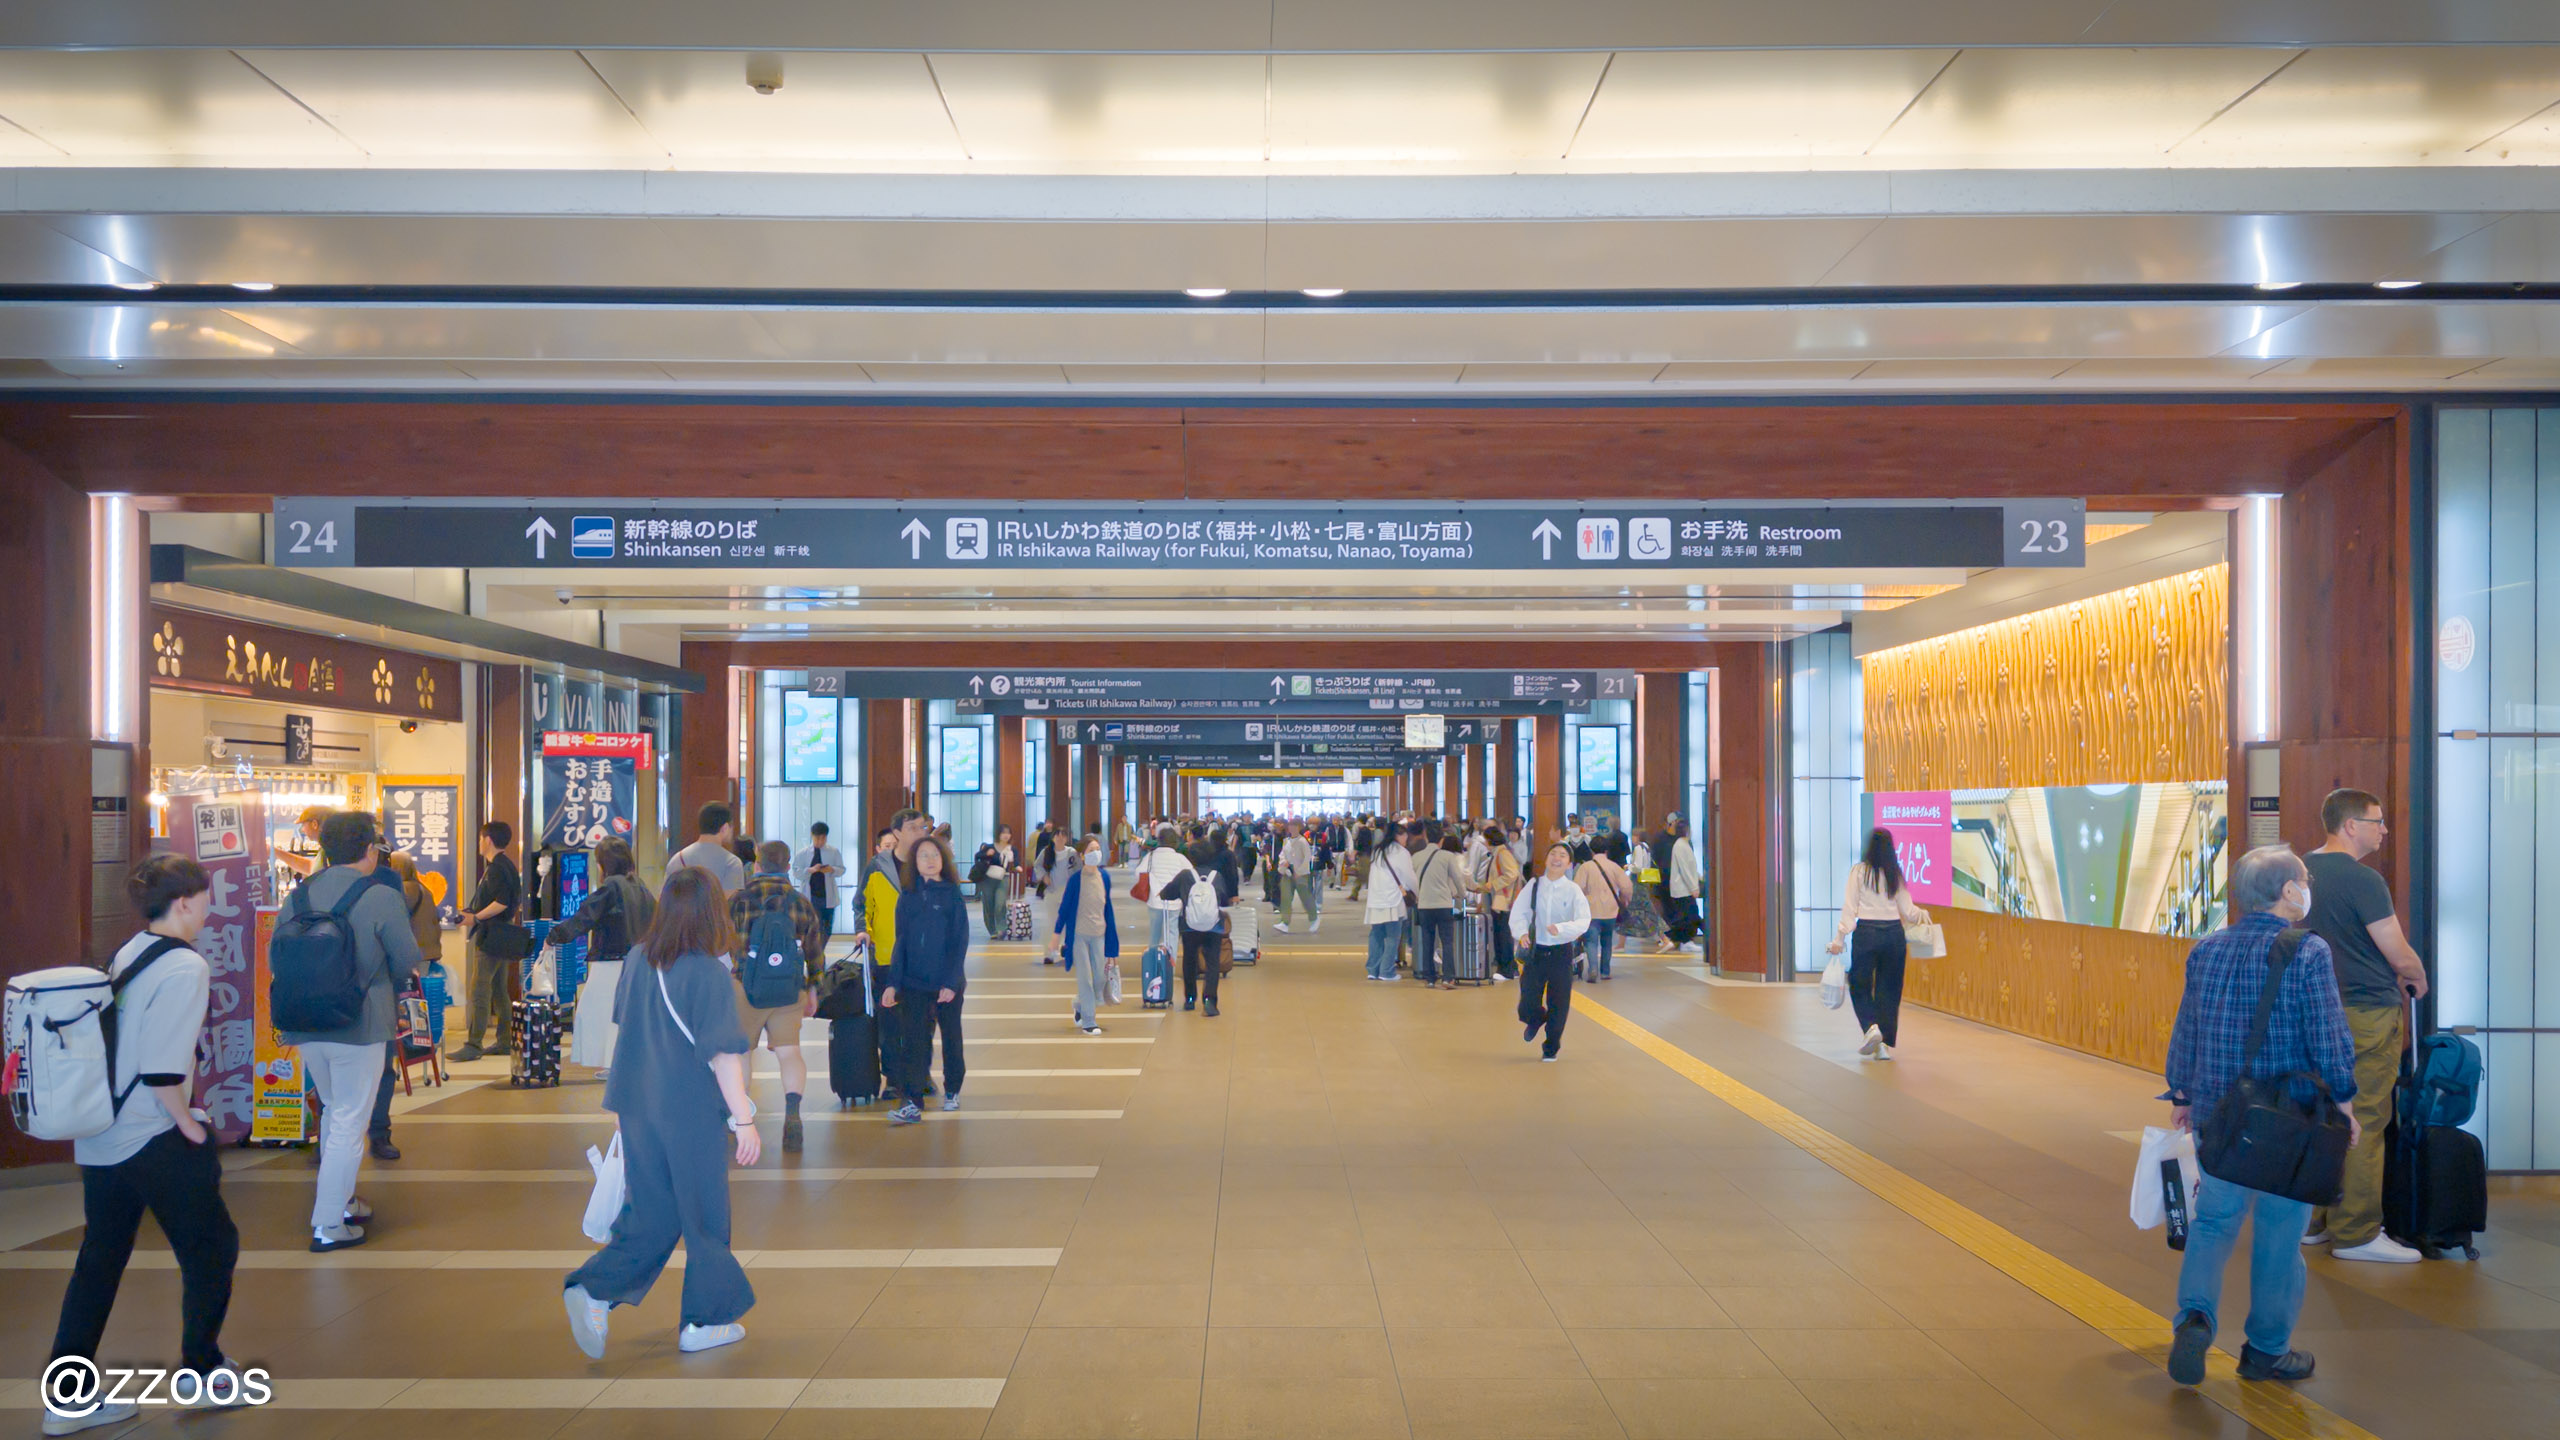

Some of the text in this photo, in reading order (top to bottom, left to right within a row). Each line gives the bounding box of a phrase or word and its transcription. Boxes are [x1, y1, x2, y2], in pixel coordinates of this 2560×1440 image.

[289, 521, 338, 553] 24
[624, 519, 758, 540] 新幹線のりば
[1681, 519, 1842, 540] お手洗 Restroom
[2020, 520, 2068, 553] 23
[624, 541, 721, 557] Shinkansen
[730, 545, 765, 557] 신칸센
[998, 543, 1473, 561] IR Ishikawa Railway (for Fukui, Komatsu, Nanao, Toyama)
[1681, 545, 1714, 557] 화장실
[814, 676, 838, 692] 22
[1014, 676, 1142, 687] 観光案内所 Tourist Information
[1603, 677, 1625, 694] 21
[1055, 699, 1084, 708] Tickets
[1100, 699, 1138, 708] Ishikawa
[1139, 699, 1176, 710] Railway)
[565, 694, 599, 734] VIA
[1059, 724, 1077, 739] 18
[1127, 724, 1180, 733] 新幹線のりば
[1482, 724, 1499, 739] 17
[596, 735, 643, 748] コロッケ
[589, 758, 613, 825] 手造り
[563, 757, 588, 847] おむすび
[421, 790, 449, 862] 能登牛
[394, 809, 418, 862] コロッ
[14, 1039, 29, 1090] THE
